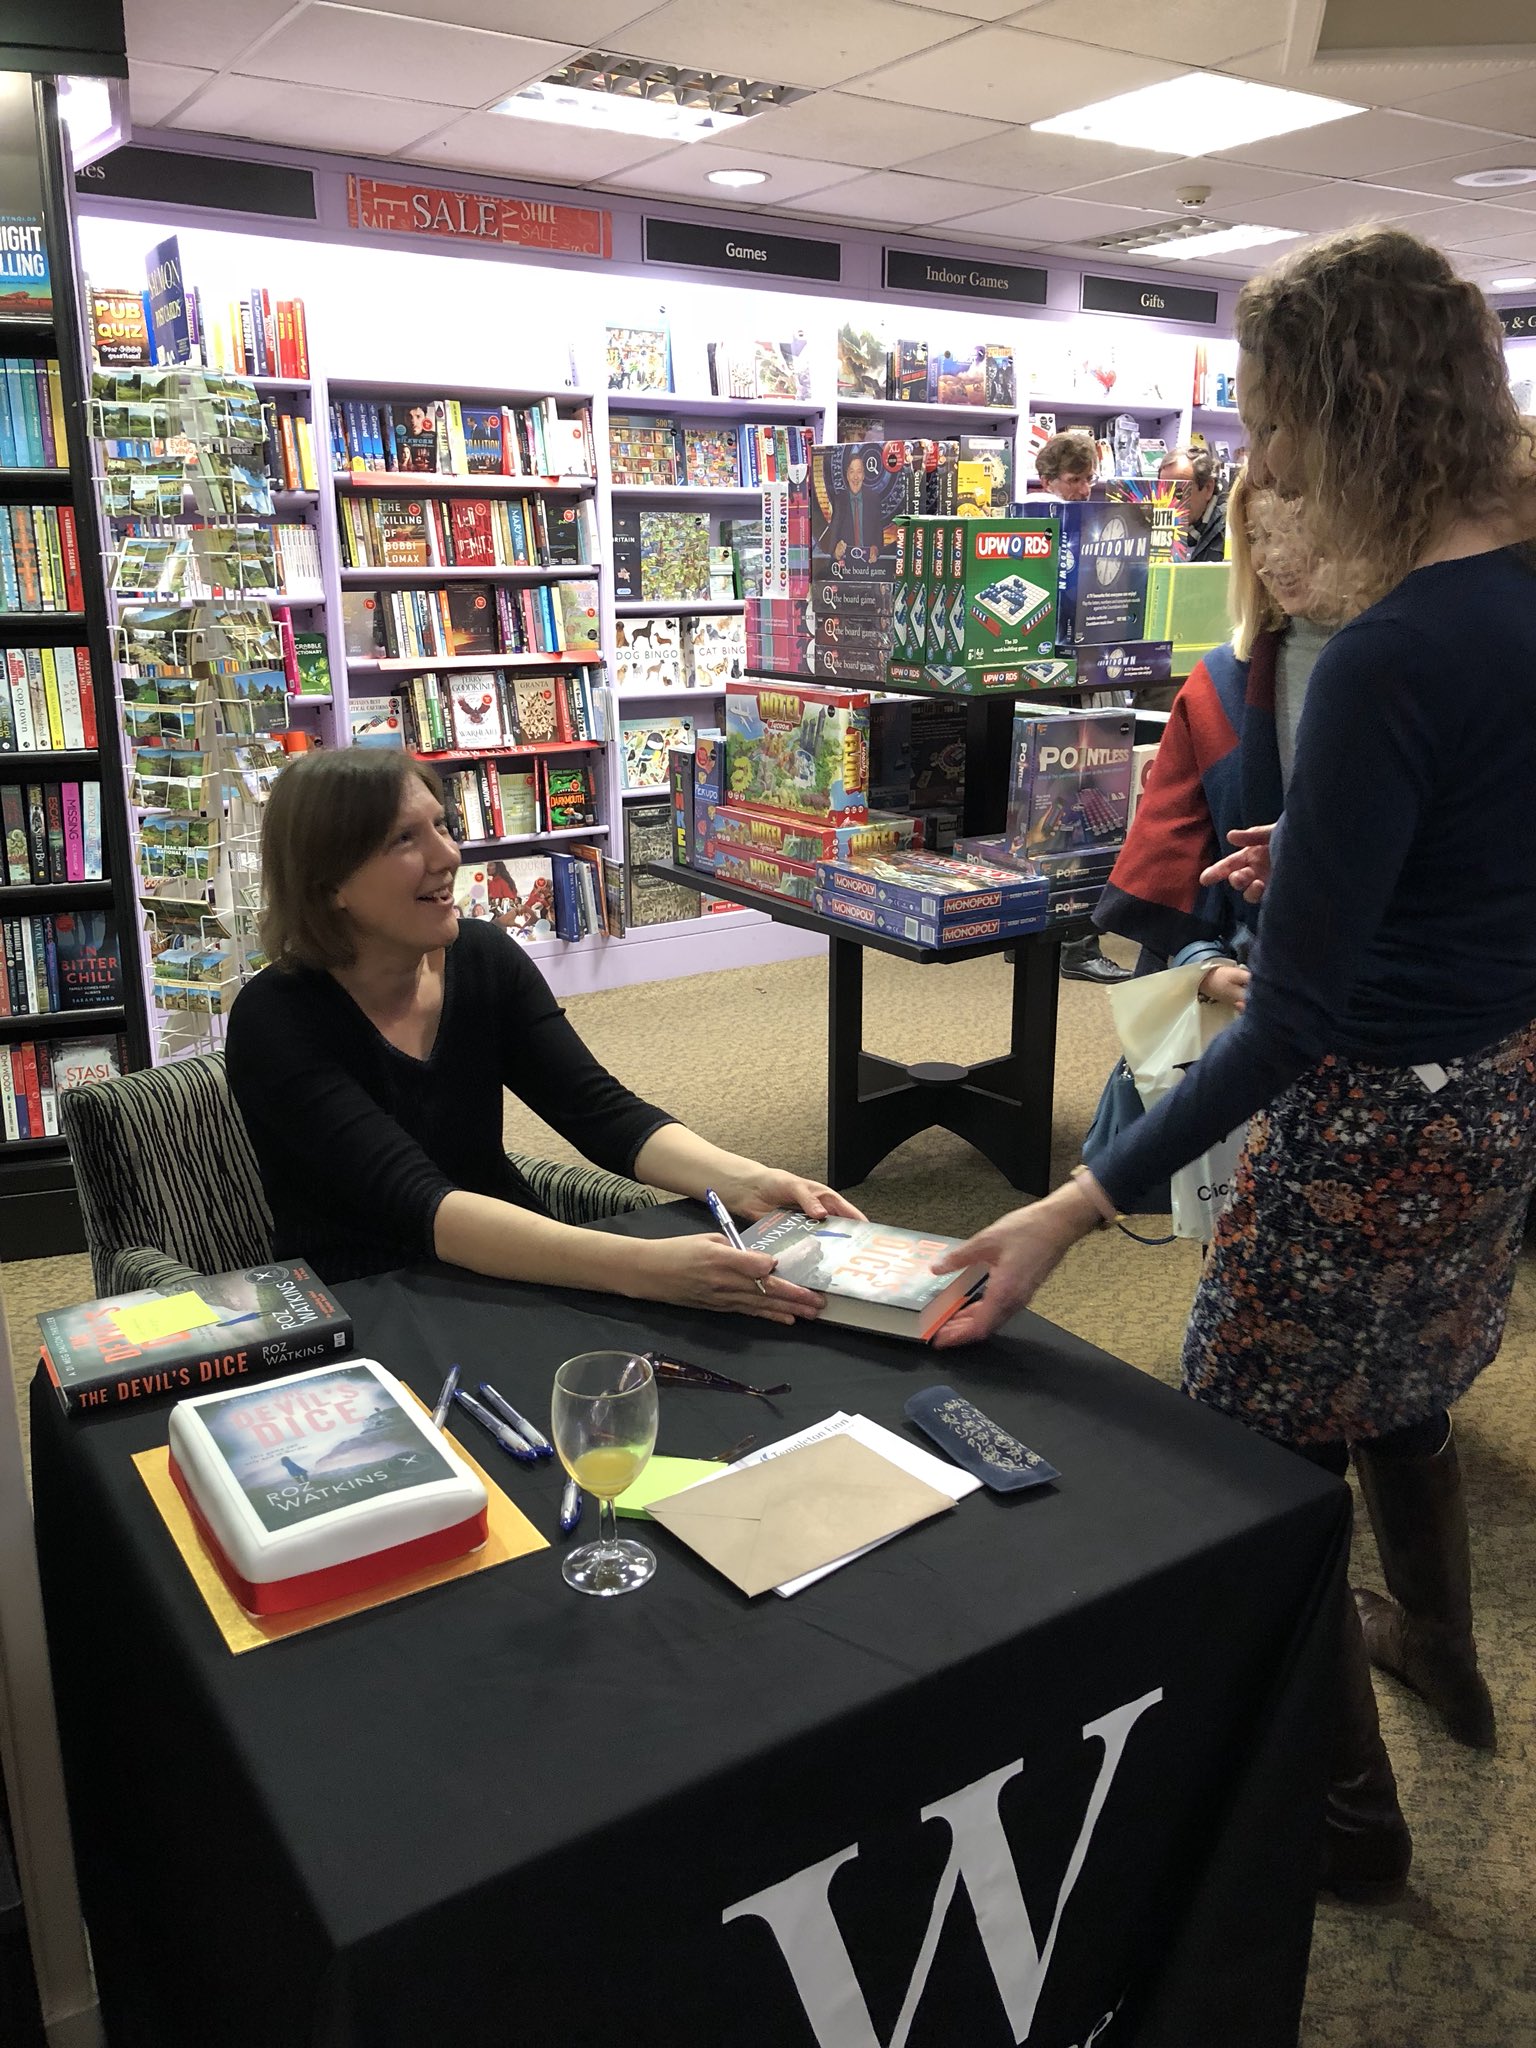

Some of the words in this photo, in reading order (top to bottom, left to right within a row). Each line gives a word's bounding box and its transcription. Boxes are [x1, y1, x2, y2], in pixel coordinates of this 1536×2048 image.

[412, 193, 499, 238] SALE
[726, 242, 768, 262] Games
[926, 265, 966, 284] Indoor
[969, 270, 1009, 290] Games
[94, 299, 142, 319] PUB
[1140, 292, 1165, 309] Gifts
[98, 323, 144, 339] QUIZ
[360, 413, 369, 438] Ireland
[371, 415, 379, 439] Greece
[382, 503, 401, 512] THE
[764, 492, 772, 533] BRAIN
[779, 492, 787, 533] BRAIN
[383, 516, 422, 525] KILLING
[64, 518, 74, 548] VANISHING
[384, 529, 397, 538] OF
[386, 541, 416, 550] BOBBI
[978, 535, 1051, 556] UPWORDS
[1079, 535, 1143, 554] COUNTDOWN
[67, 548, 76, 570] SEASON
[386, 554, 420, 563] LOMAX
[1057, 529, 1066, 586] COUNTDOWN
[842, 566, 852, 574] the
[852, 566, 866, 575] board
[866, 569, 887, 578] game
[833, 595, 842, 604] the
[842, 595, 860, 604] board
[860, 597, 876, 607] game
[834, 627, 844, 636] the
[844, 627, 861, 637] board
[860, 630, 876, 639] game
[295, 642, 322, 650] CRABBLE
[615, 651, 640, 661] DOG
[644, 649, 679, 660] BINGO
[698, 646, 717, 657] CAT
[8, 652, 19, 686] SLAUGHTER
[17, 660, 26, 679] KARIN
[77, 651, 85, 671] CRUZ
[834, 660, 843, 668] the
[843, 660, 859, 669] board
[859, 663, 875, 673] game
[79, 672, 88, 695] SMITH
[84, 659, 92, 687] MARTIN
[461, 675, 484, 684] TERRY
[983, 671, 1018, 683] UPWORDS
[519, 681, 549, 690] GRANTA
[16, 688, 25, 706] cop
[63, 683, 71, 713] PARK
[69, 679, 79, 717] GORKY
[20, 708, 29, 733] town
[1038, 746, 1129, 772] POINTLESS
[66, 799, 79, 841] MISSING
[836, 874, 876, 896] MONOPOLY
[833, 901, 875, 922] MONOPOLY
[944, 895, 1000, 913] MONOPOLY
[33, 918, 42, 942] FATAL
[943, 922, 999, 940] MONOPOLY
[36, 942, 46, 975] PURSUIT
[79, 946, 97, 958] IN
[62, 957, 119, 972] BITTER
[66, 972, 116, 984] CHILL
[95, 995, 116, 1003] WARD
[0, 1051, 9, 1068] TOM
[3, 1068, 11, 1093] WOOD
[66, 1064, 110, 1082] STASI
[759, 1216, 830, 1267] WATKINS
[816, 1224, 846, 1247] OZ
[863, 1236, 961, 1301] DICE
[275, 1280, 318, 1330] WATKINS
[270, 1309, 297, 1336] ROZ
[262, 1341, 288, 1360] ROZ
[265, 1344, 324, 1371] WATKINS
[79, 1388, 109, 1408] THE
[117, 1367, 190, 1401] DEVIL'S
[200, 1352, 249, 1383] DICE
[229, 1382, 361, 1430] DEVIL'S
[248, 1399, 370, 1449] DICE
[771, 1429, 827, 1458] Templeton
[824, 1418, 850, 1434] Finn
[266, 1481, 315, 1507] ROZ
[275, 1470, 389, 1513] WATKINS
[722, 1686, 1163, 2048] W
